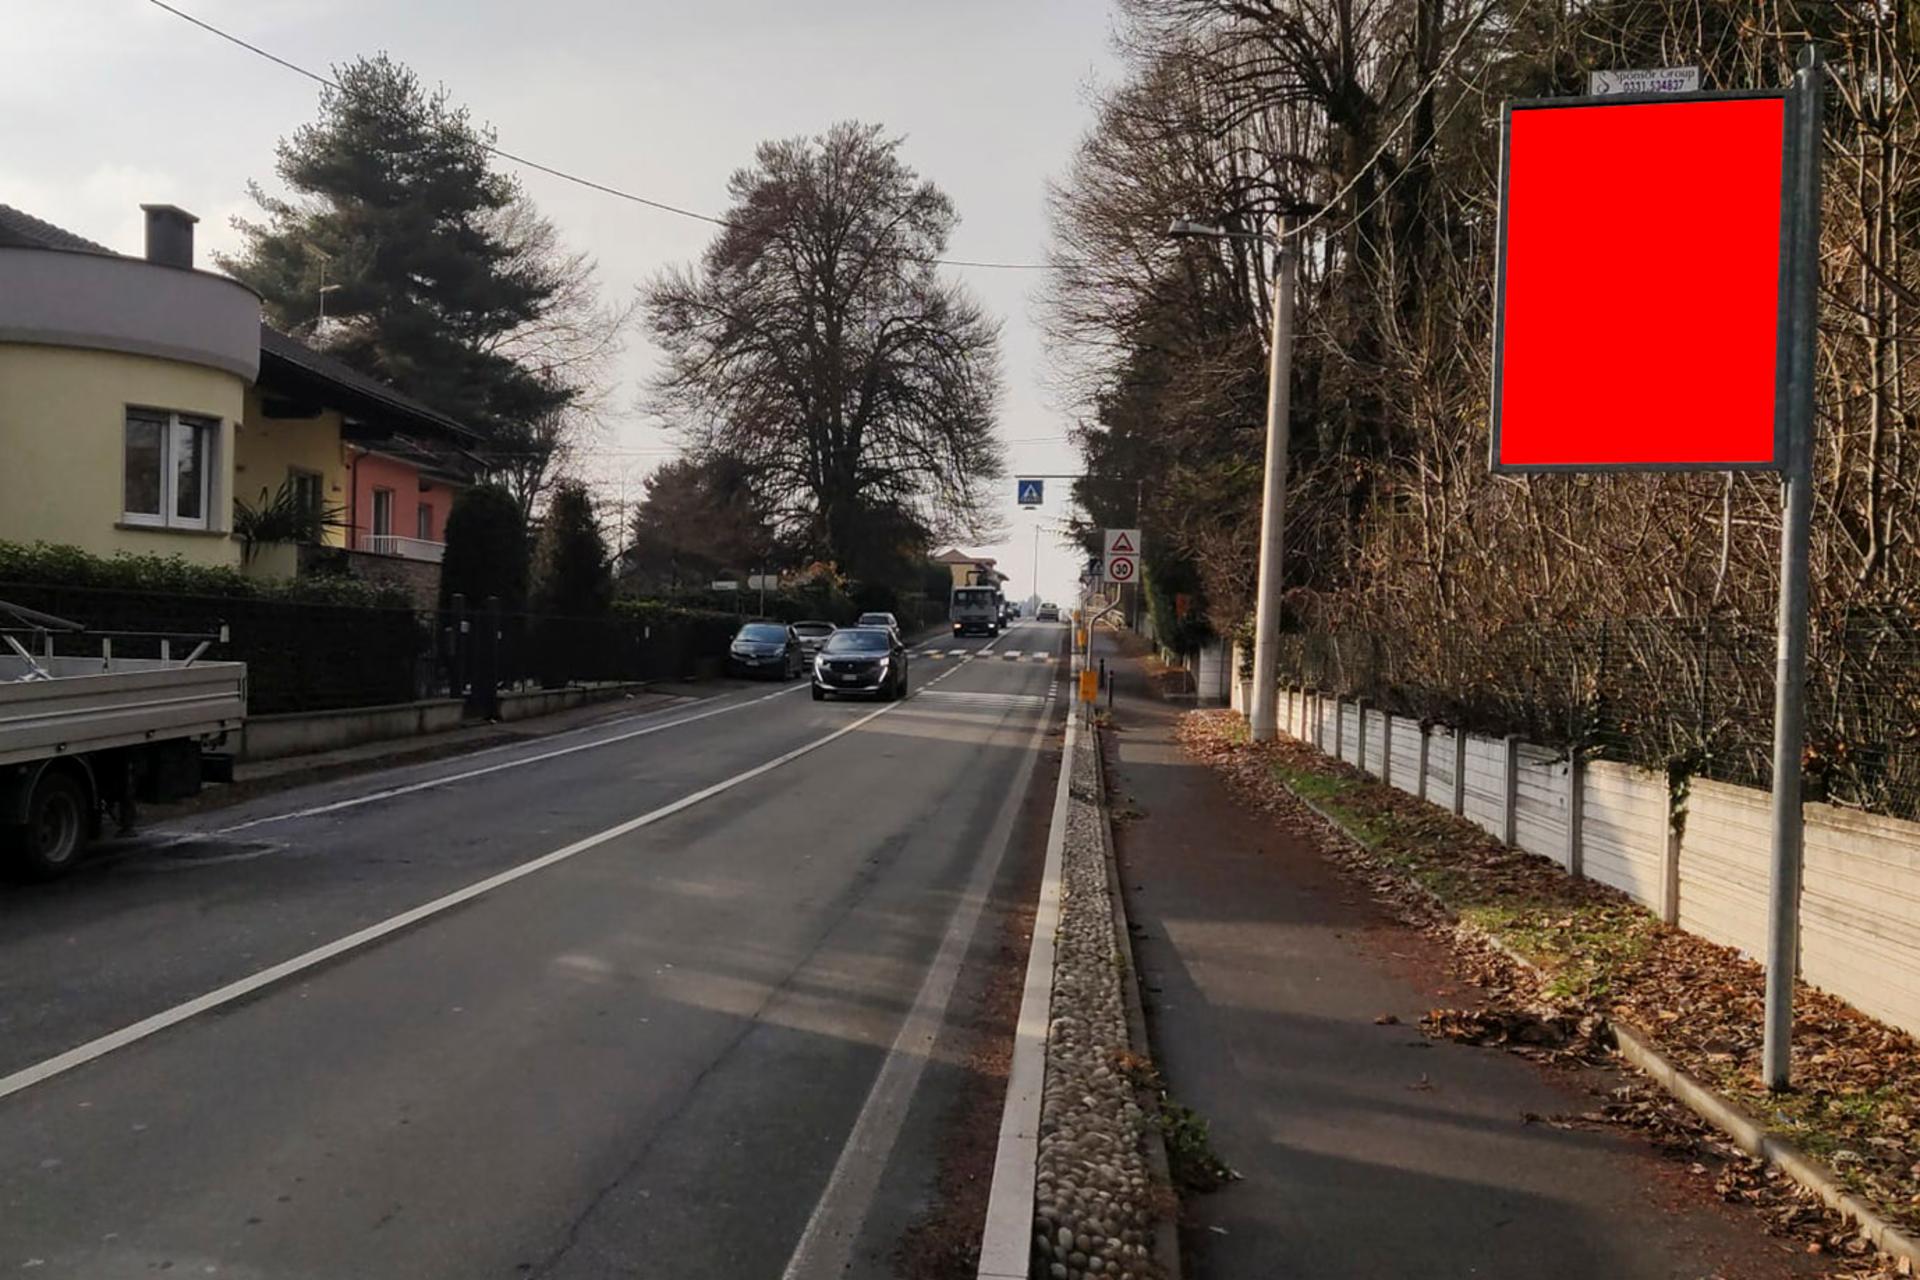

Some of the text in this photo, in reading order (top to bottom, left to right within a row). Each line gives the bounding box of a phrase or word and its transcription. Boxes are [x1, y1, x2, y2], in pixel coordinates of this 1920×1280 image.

[1615, 69, 1695, 84] Sponsor Group
[1115, 563, 1128, 575] 30
